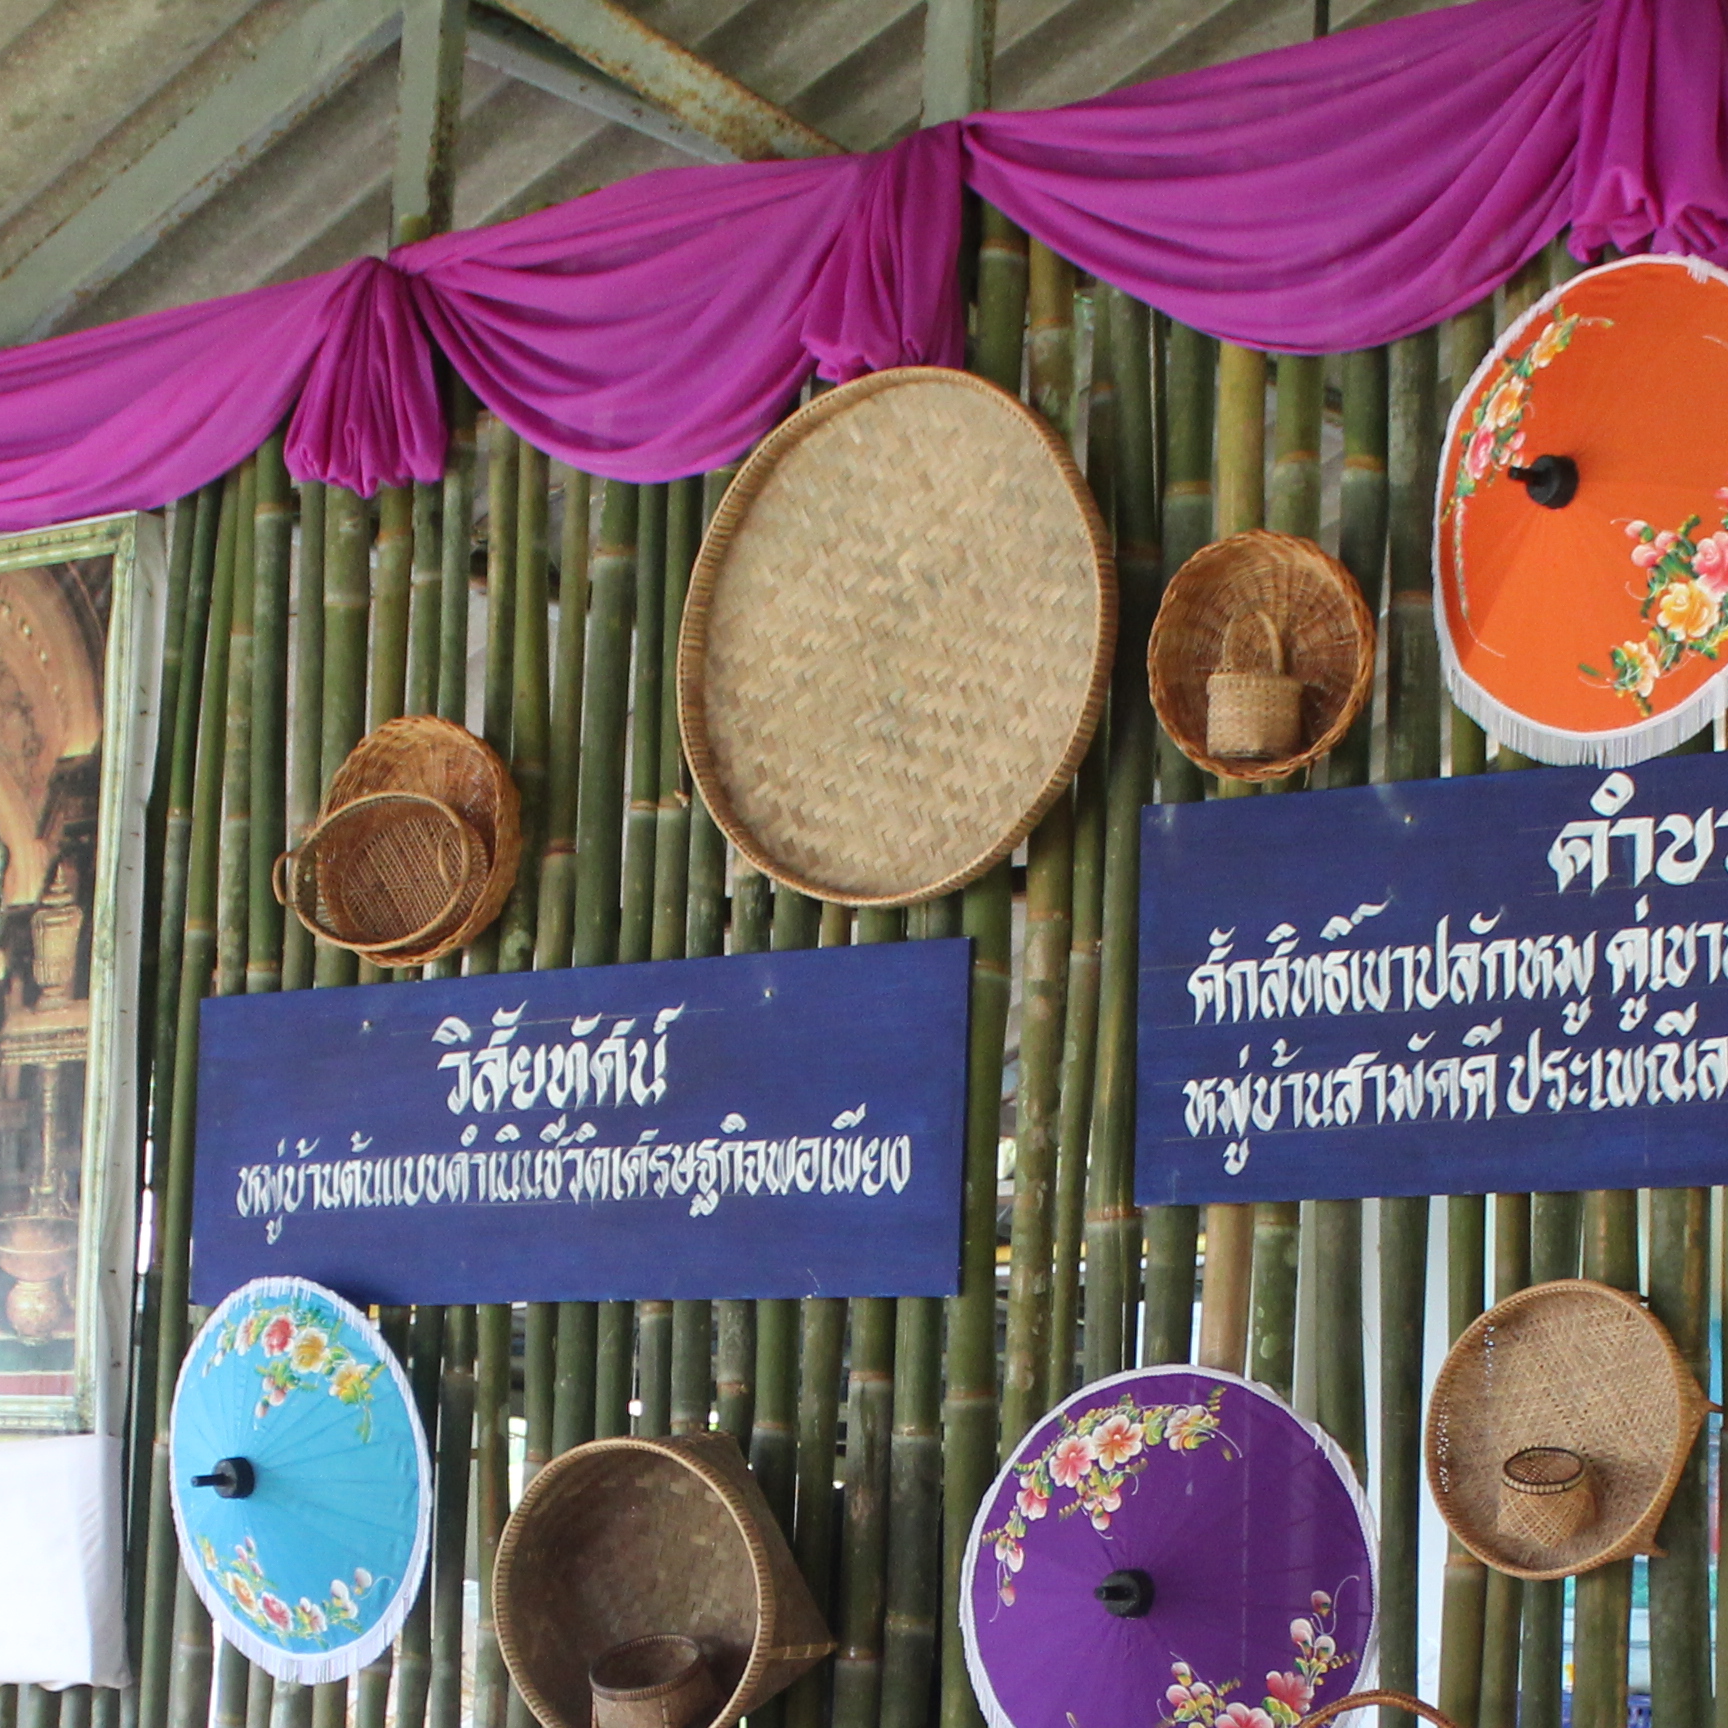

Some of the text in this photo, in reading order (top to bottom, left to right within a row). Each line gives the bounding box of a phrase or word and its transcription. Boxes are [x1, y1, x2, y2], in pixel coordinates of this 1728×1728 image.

[432, 1000, 685, 1115] วิสัยทัศน์
[1182, 1017, 1503, 1176] หมู่บ้านสามัคคี
[236, 1102, 911, 1246] หมู่บ้านต้นแบบดำเนินชีวิตเศรษฐกิจพอเพียง
